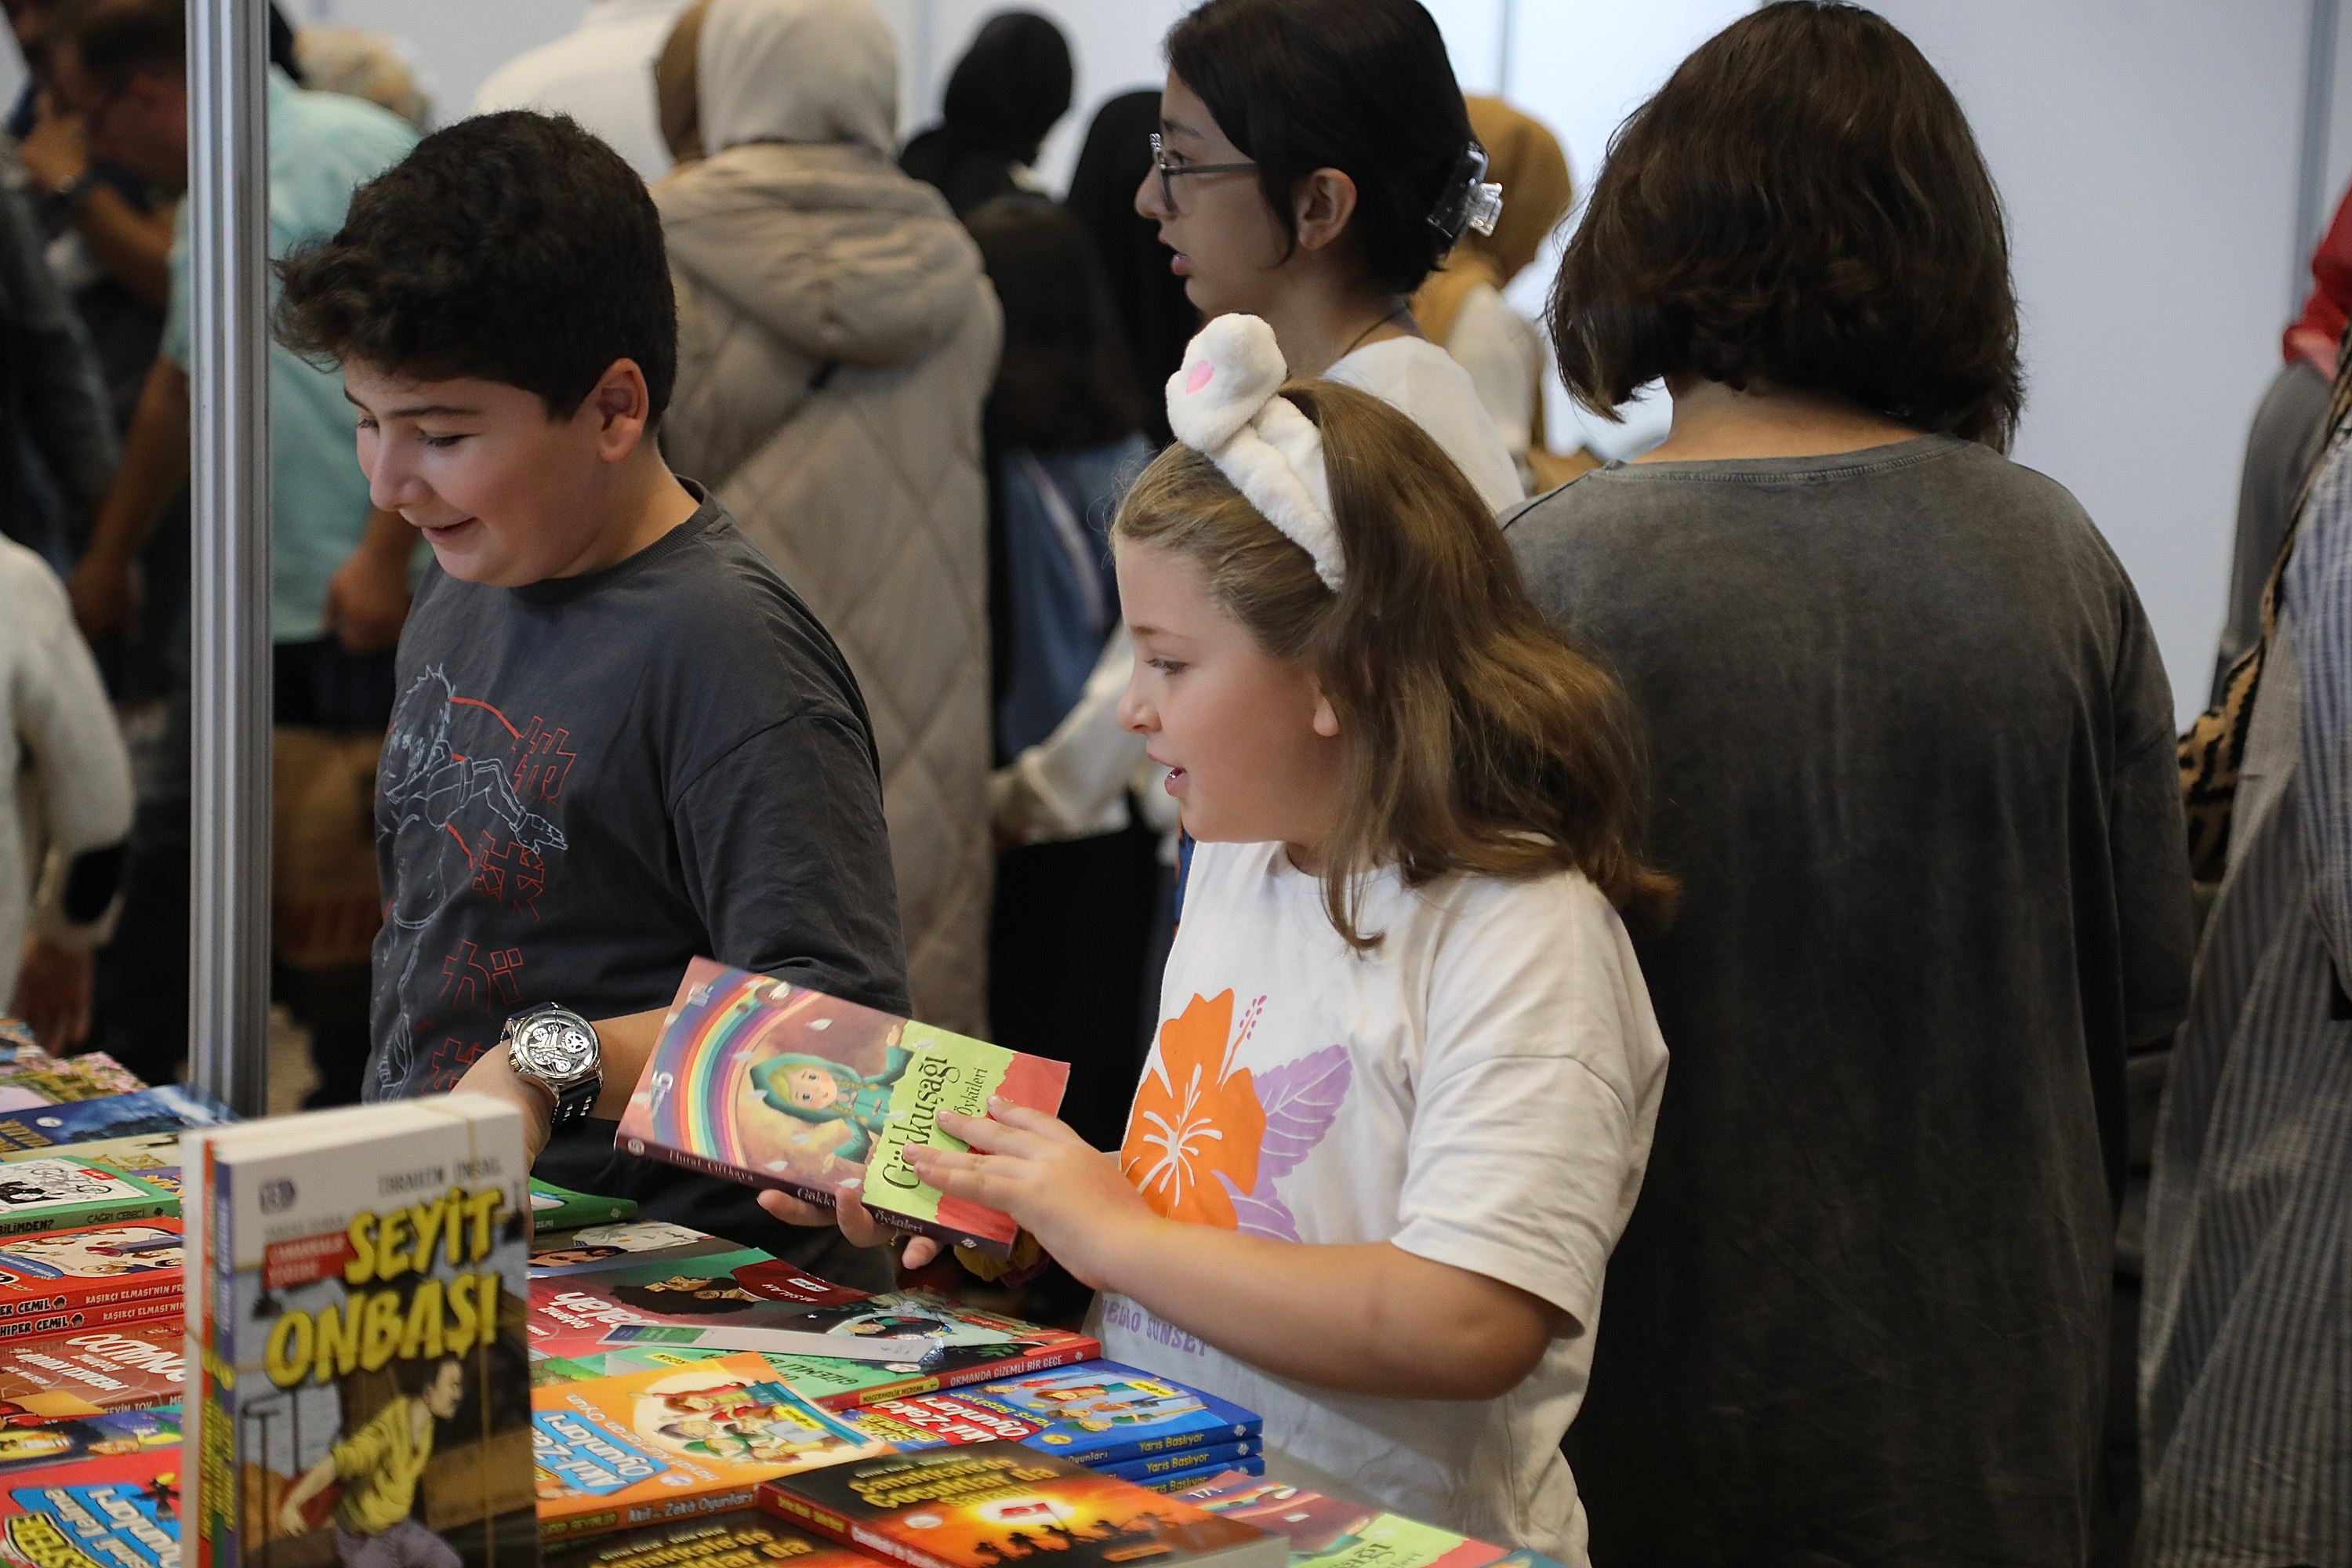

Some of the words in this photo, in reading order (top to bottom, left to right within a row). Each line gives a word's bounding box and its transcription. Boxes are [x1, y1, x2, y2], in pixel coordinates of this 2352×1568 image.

[953, 1067, 988, 1116] Öyküleri
[345, 1186, 504, 1284] SEYİT
[17, 1300, 51, 1314] CEMİL
[35, 1317, 69, 1331] CEMİL
[538, 1305, 594, 1330] Rotamız
[549, 1291, 659, 1329] alah
[264, 1270, 499, 1386] ONBAŞI
[950, 1370, 992, 1387] ORMANDA
[994, 1363, 1025, 1378] GİZEMLİ
[1027, 1358, 1042, 1371] BİR
[1043, 1356, 1062, 1370] GECE
[566, 1393, 606, 1421] Oyun
[916, 1396, 1031, 1438] Oyunları
[541, 1414, 655, 1477] Oyunları
